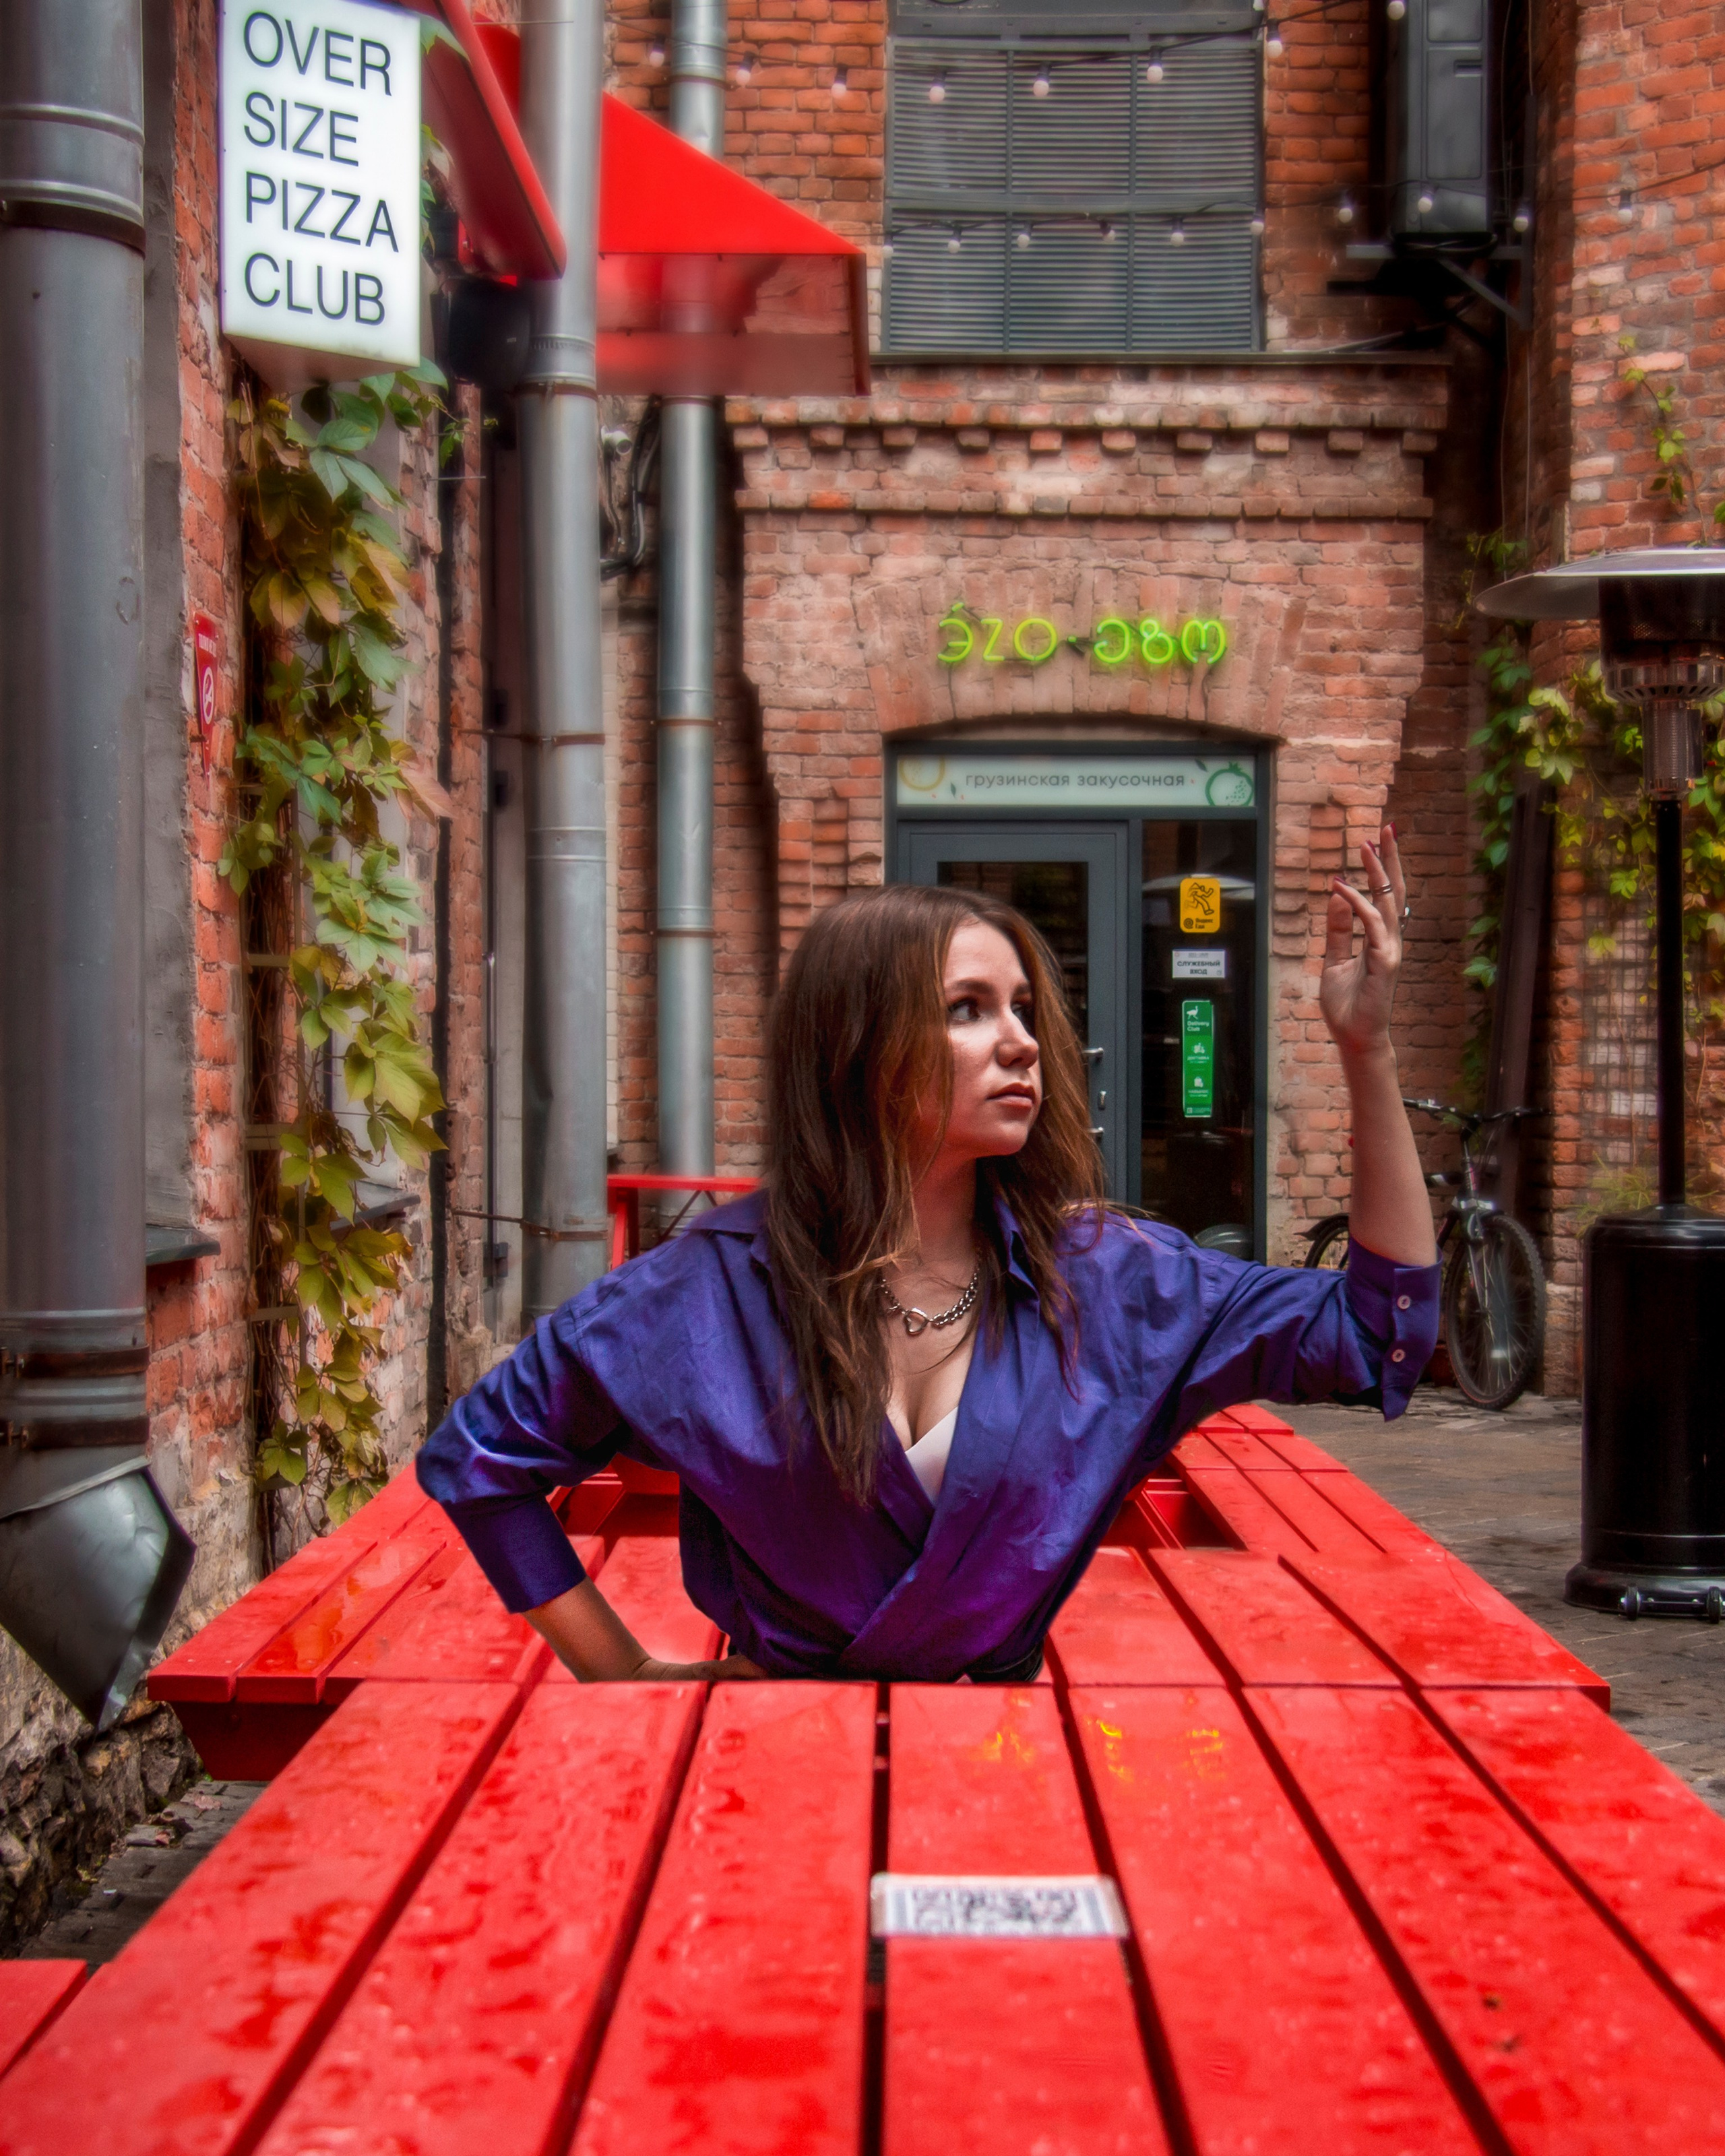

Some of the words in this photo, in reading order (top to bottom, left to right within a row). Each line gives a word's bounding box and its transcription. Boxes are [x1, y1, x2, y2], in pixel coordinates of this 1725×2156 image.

[243, 11, 391, 96] OVER
[244, 92, 359, 167] SIZE
[246, 170, 399, 253] PIZZA
[245, 252, 385, 326] CLUB
[966, 774, 1070, 789] грузинская
[1077, 774, 1185, 789] закусочная
